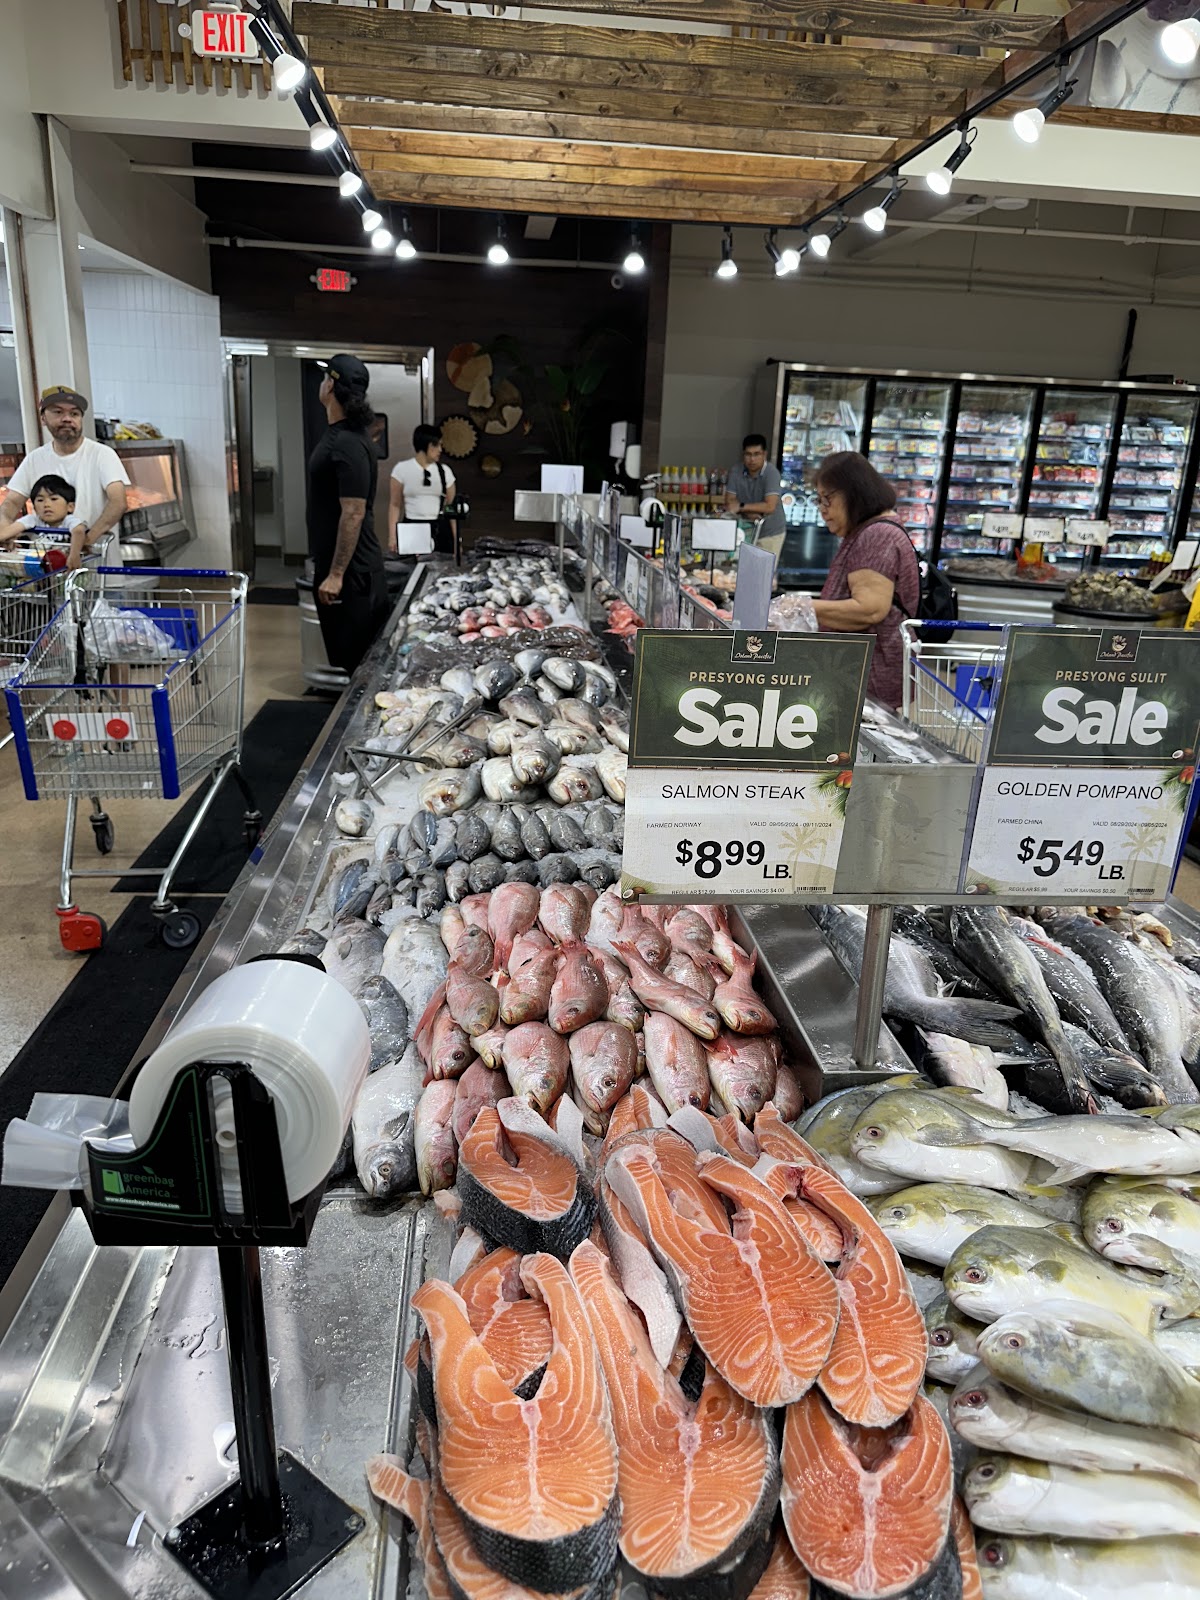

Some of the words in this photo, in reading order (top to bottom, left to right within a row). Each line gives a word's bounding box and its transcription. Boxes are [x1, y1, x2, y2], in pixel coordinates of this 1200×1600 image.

[203, 13, 247, 53] EXIT
[322, 268, 346, 290] EXIT
[689, 671, 766, 685] PRESYONG
[770, 674, 811, 686] SULIT
[1055, 670, 1126, 683] PRESYONG
[1129, 672, 1167, 684] SULIT
[673, 687, 818, 749] Sale
[1034, 686, 1169, 746] Sale
[661, 784, 739, 799] SALMON
[745, 785, 806, 799] STEAK
[997, 781, 1072, 797] GOLDEN
[1076, 783, 1163, 800] POMPANO
[763, 864, 792, 879] LB.
[1098, 864, 1126, 880] LB.
[123, 1173, 175, 1188] greenbag
[124, 1184, 171, 1198] America
